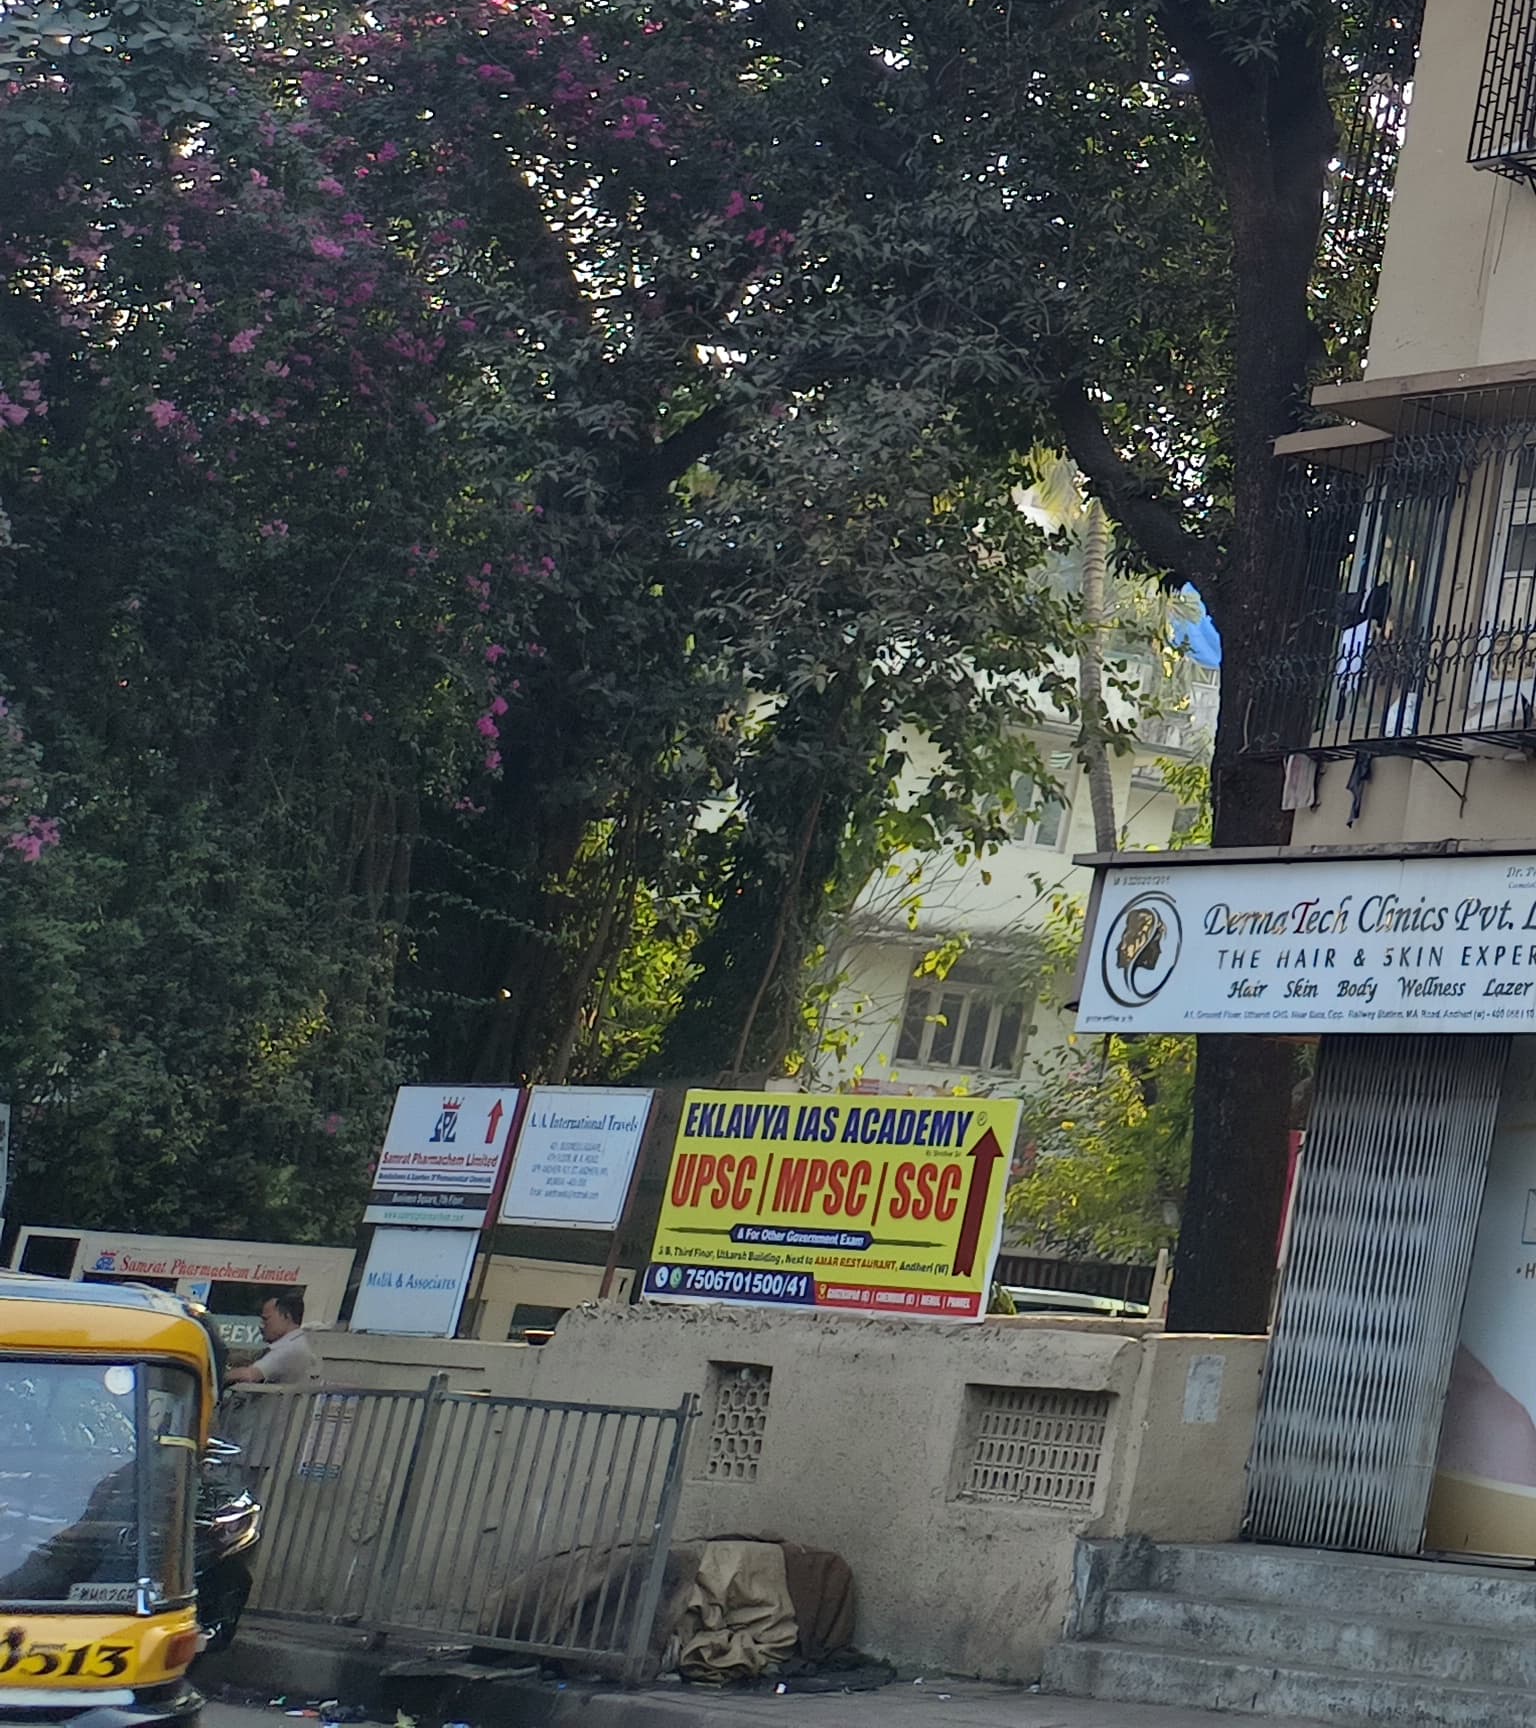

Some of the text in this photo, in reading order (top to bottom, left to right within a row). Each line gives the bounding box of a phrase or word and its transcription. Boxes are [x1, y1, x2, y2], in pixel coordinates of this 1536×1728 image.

[1359, 894, 1448, 934] Clinics
[1455, 897, 1514, 932] Pvt.
[1218, 949, 1262, 970] THE
[1276, 947, 1336, 970] HAIR
[1383, 946, 1443, 967] SKIN
[1228, 976, 1533, 1004] Hair Skin Body Wellness Lazer
[684, 1102, 975, 1148] EKLAVYA IAS ACADEMY
[671, 1153, 758, 1209] UPSC
[772, 1158, 873, 1216] MPSC
[889, 1162, 963, 1222] SSC
[118, 1255, 301, 1282] Samrat Pharmachem Limited
[685, 1268, 809, 1297] 7506701500/41
